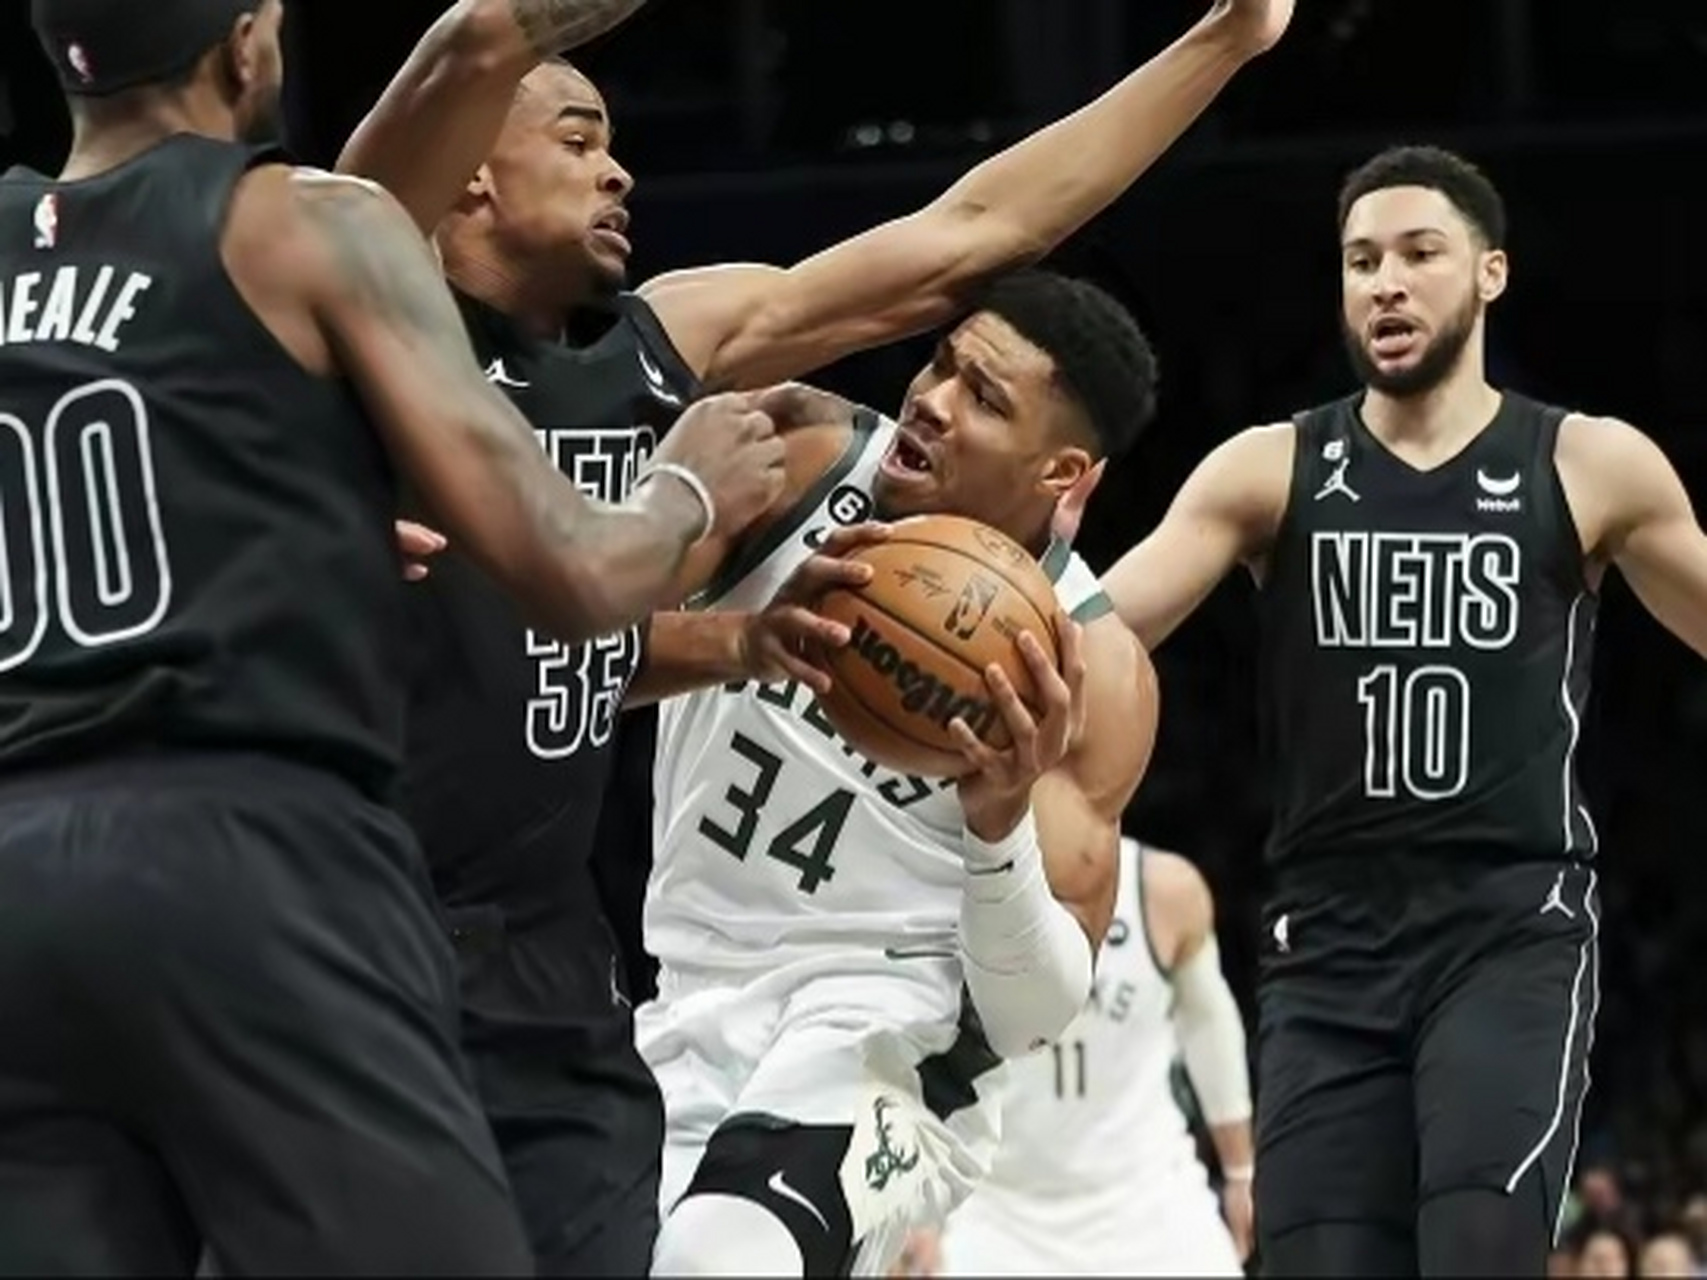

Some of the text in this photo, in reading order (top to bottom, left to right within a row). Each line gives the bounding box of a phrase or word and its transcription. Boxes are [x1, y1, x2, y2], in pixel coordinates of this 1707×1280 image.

[0, 265, 151, 351] EALE
[1322, 439, 1344, 461] 6
[832, 490, 866, 523] 6
[1312, 531, 1520, 649] NETS
[1357, 664, 1470, 799] 10
[697, 730, 857, 895] 34
[1052, 1040, 1085, 1099] 11
